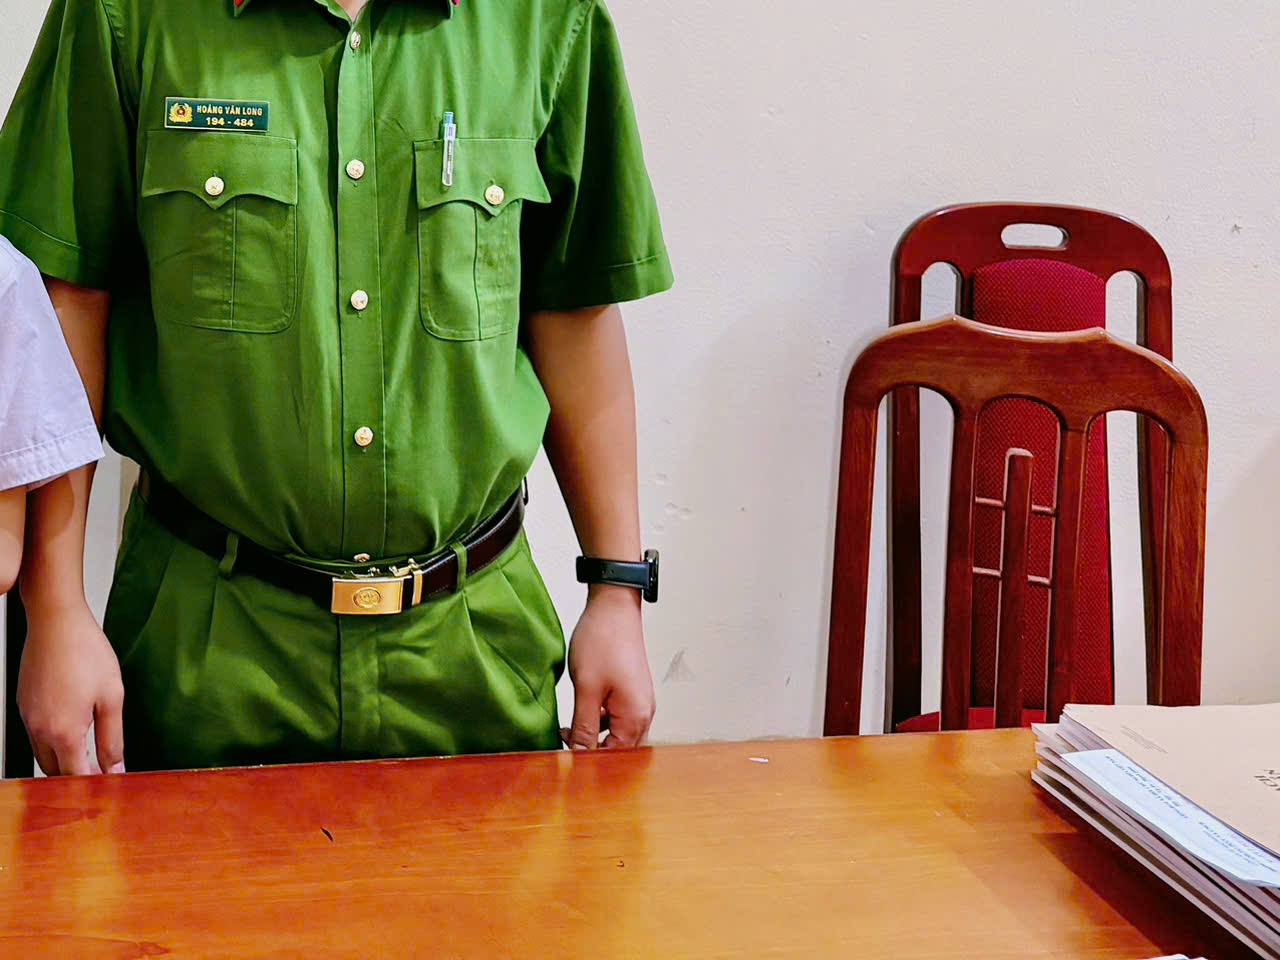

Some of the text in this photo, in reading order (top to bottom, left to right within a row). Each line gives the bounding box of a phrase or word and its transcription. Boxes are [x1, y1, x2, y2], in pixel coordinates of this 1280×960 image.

[242, 107, 263, 117] LONG
[206, 117, 225, 126] 194
[233, 118, 254, 127] 484
